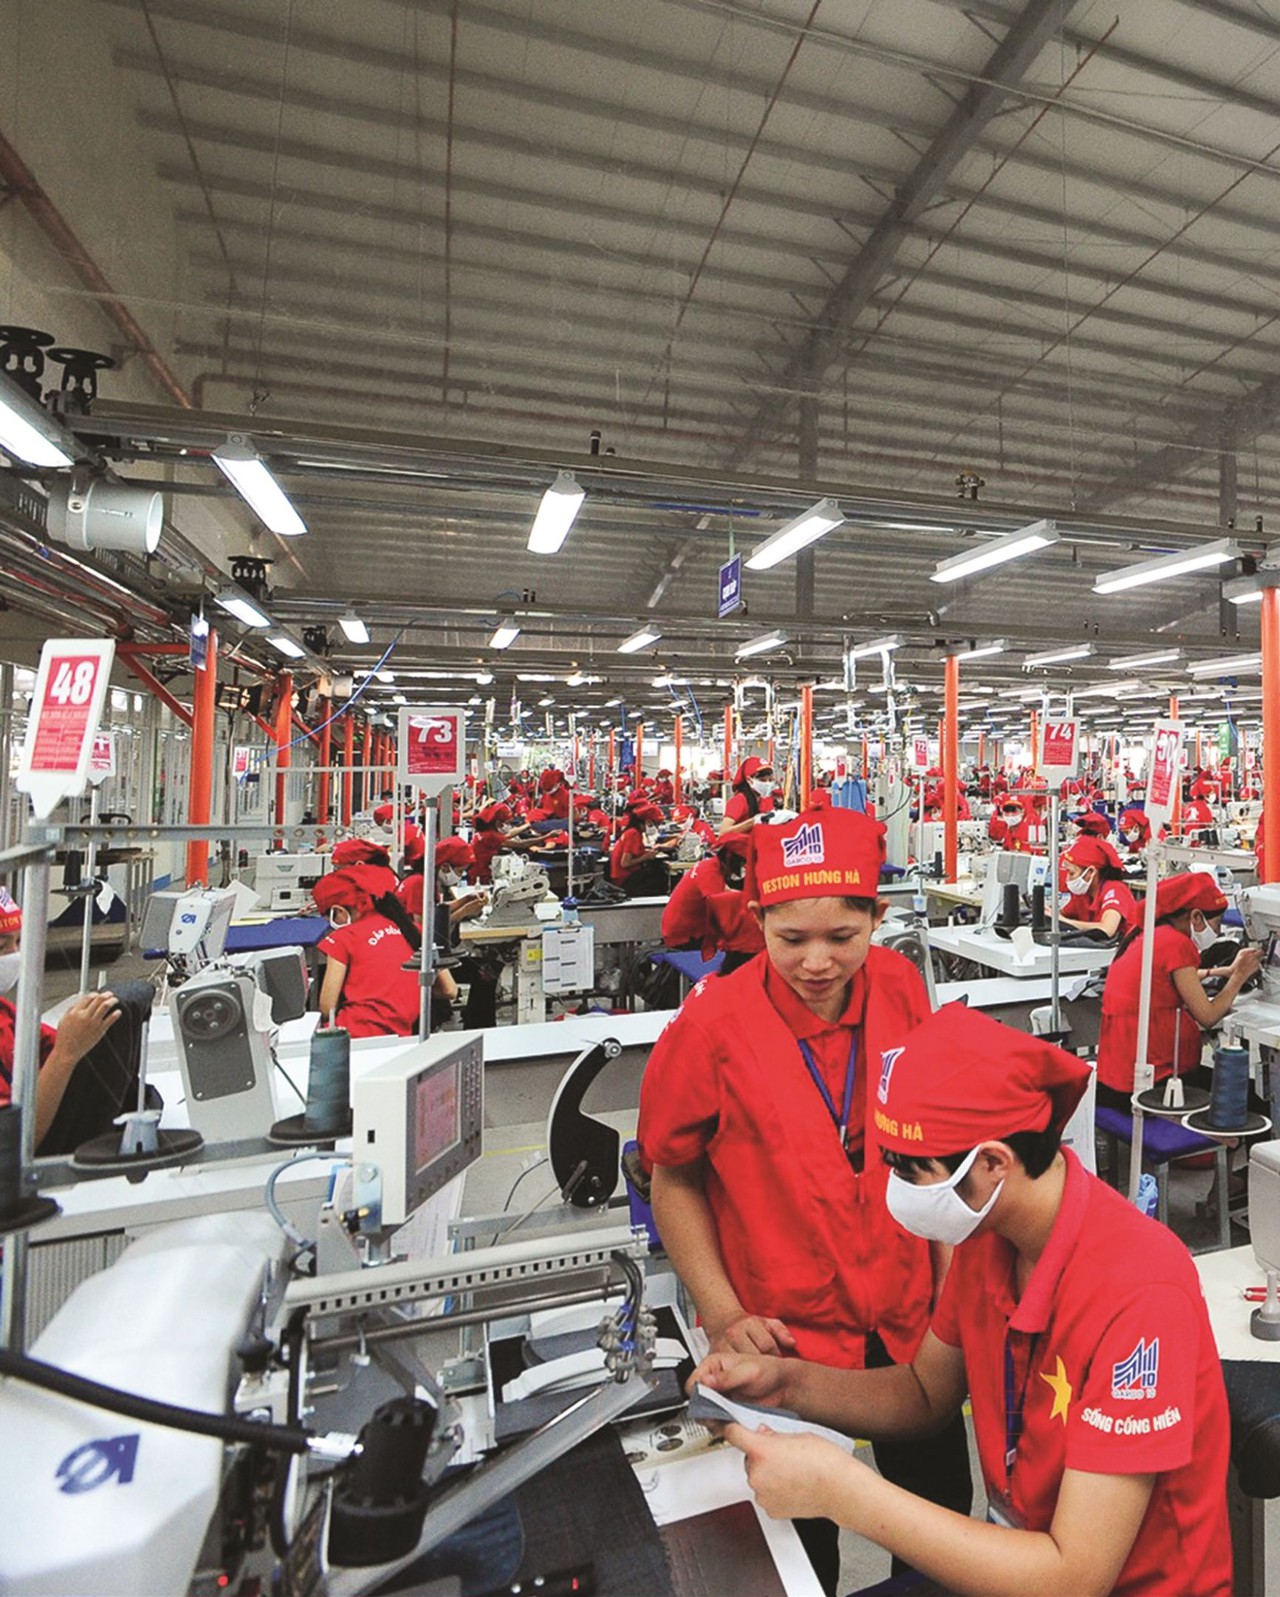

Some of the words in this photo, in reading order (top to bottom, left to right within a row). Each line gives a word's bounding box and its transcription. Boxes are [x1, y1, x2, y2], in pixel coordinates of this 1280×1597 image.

[50, 660, 94, 705] 48
[412, 720, 452, 743] 73
[1049, 723, 1072, 740] 74
[845, 867, 861, 885] HÀ
[902, 1121, 924, 1141] HÀ
[1142, 1372, 1156, 1387] 10
